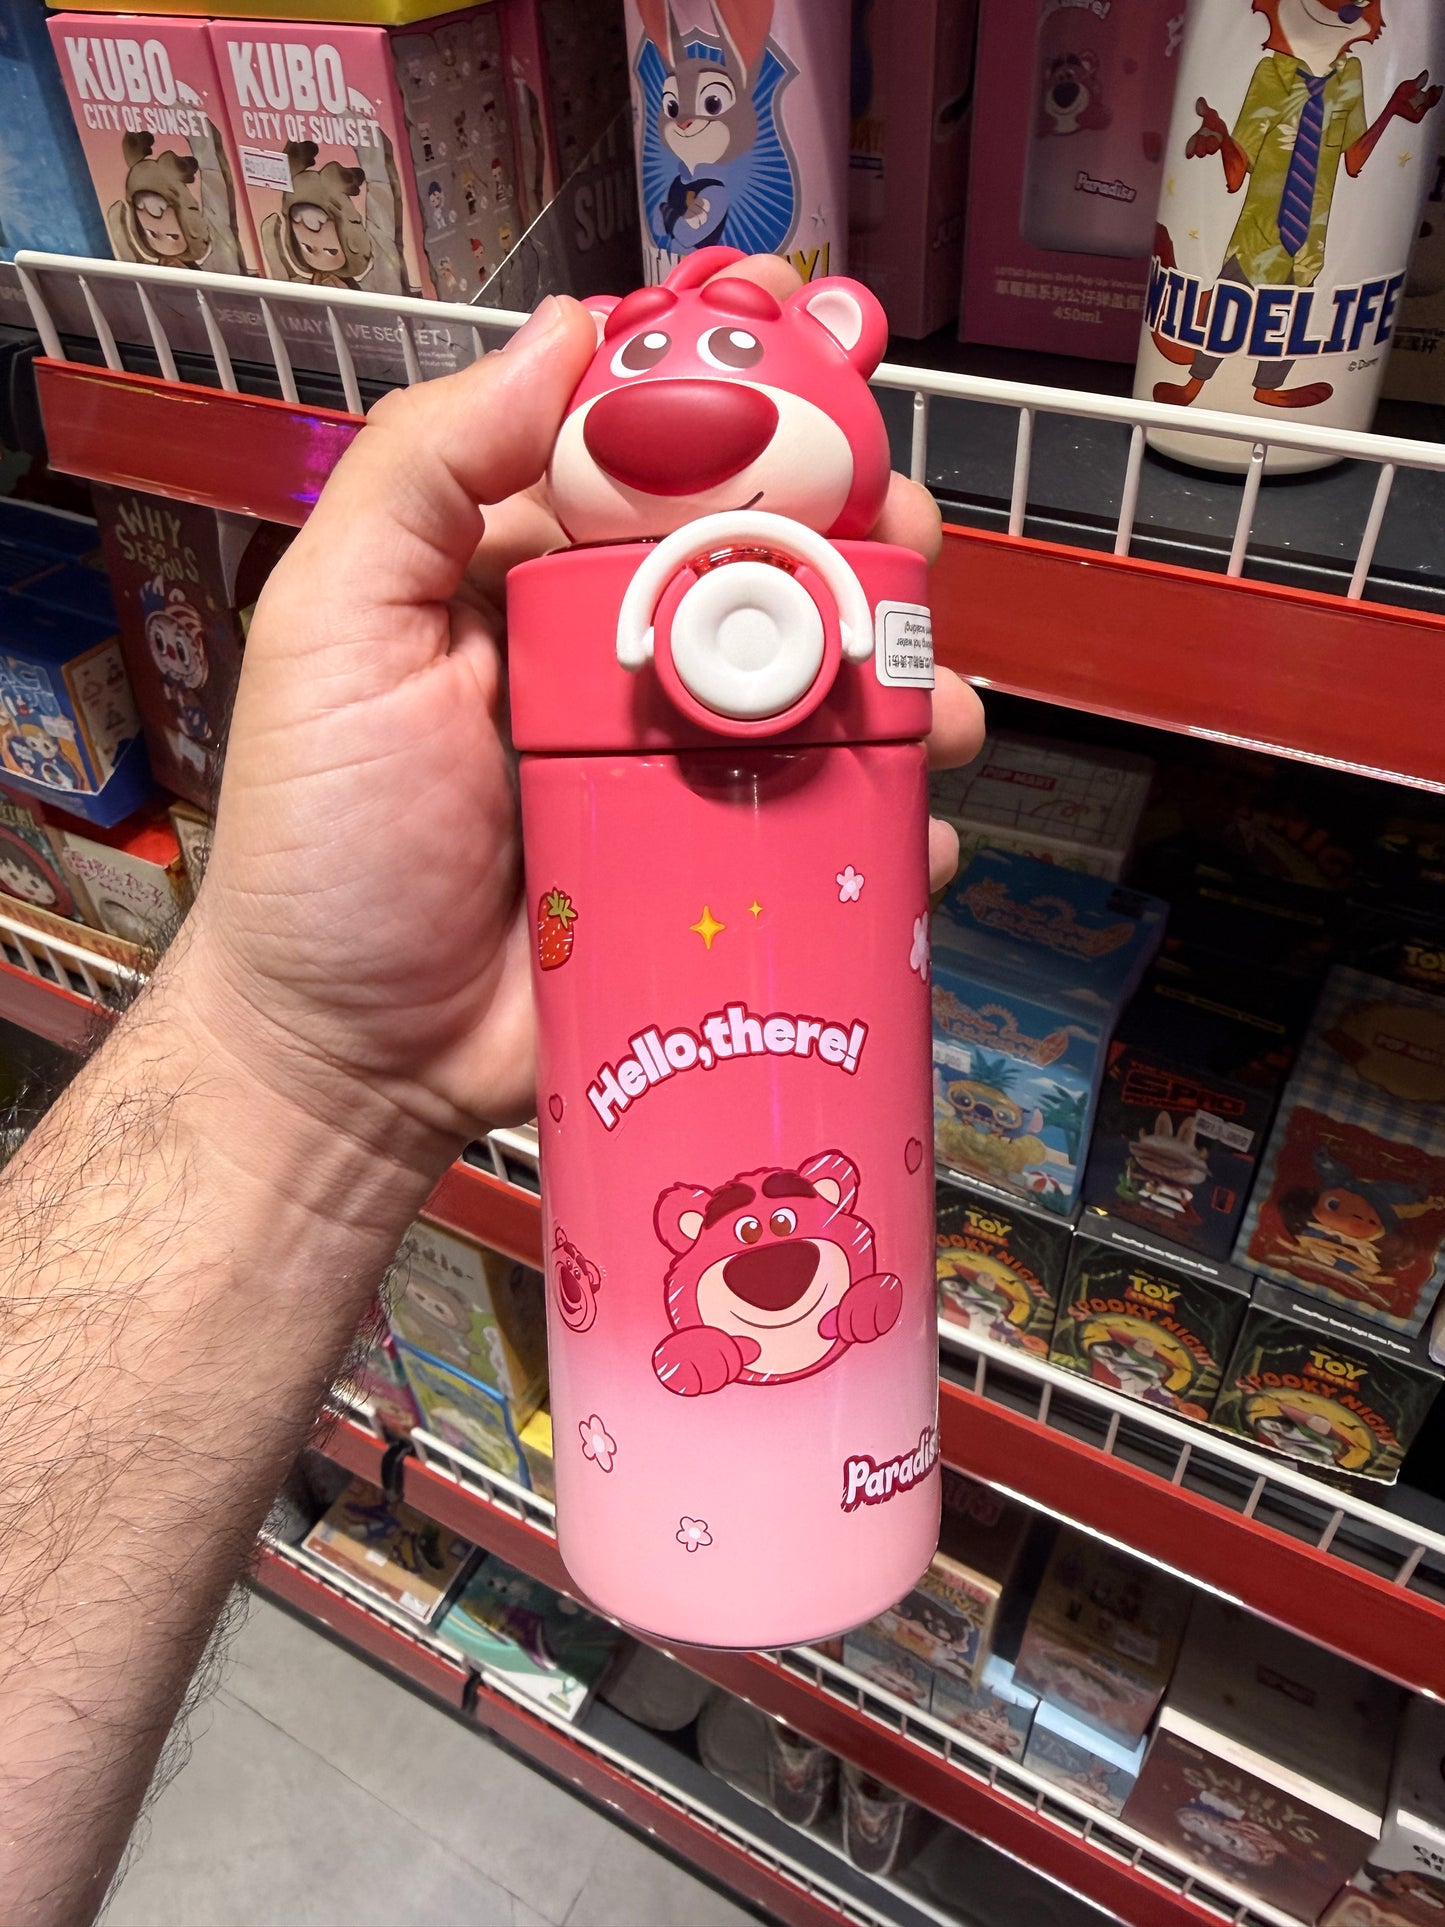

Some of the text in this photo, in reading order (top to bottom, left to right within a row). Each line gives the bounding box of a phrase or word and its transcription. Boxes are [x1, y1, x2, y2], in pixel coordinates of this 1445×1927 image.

[64, 36, 177, 106] KUBO
[227, 41, 347, 115] KUBO
[83, 103, 210, 138] CITY OF SUNSET
[243, 111, 379, 148] CITY OF SUNSET
[1145, 255, 1407, 361] WILDELIFE
[118, 496, 181, 549] WHY
[965, 1209, 1013, 1236] TOY
[1129, 1274, 1182, 1302] TOY
[1067, 1297, 1158, 1322] SPOOKY
[1310, 1349, 1369, 1380] TOY
[1234, 1371, 1339, 1398] SPOOKY
